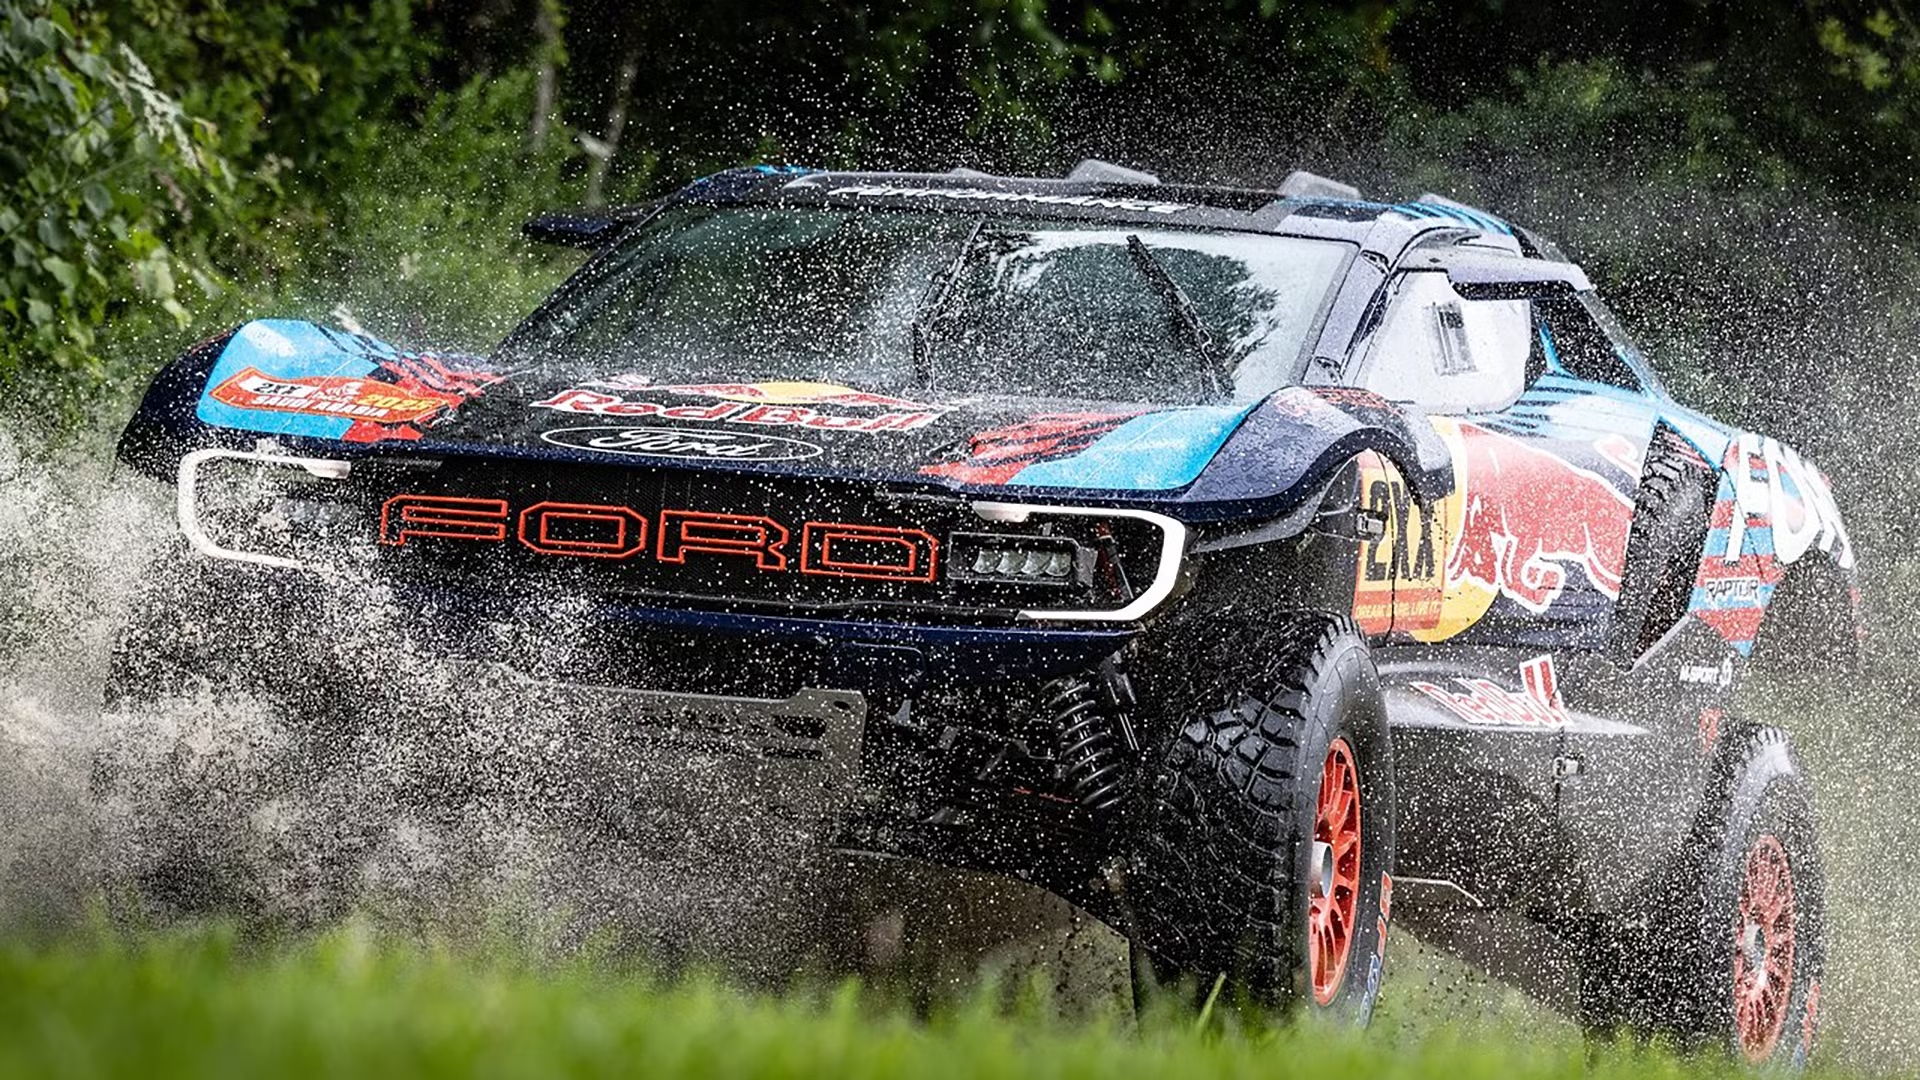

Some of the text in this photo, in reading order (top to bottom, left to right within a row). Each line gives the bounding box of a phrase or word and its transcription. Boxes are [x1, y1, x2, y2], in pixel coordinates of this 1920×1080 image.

[251, 396, 389, 417] SAUDI ARABIA
[253, 382, 302, 396] 2XX
[357, 394, 436, 411] 2025
[530, 389, 950, 432] Red Bull
[588, 429, 773, 457] Ford
[1723, 433, 1858, 570] FOR
[380, 494, 940, 581] FORD
[1365, 480, 1435, 581] 2XX
[1706, 580, 1759, 600] RAPTOR
[1409, 654, 1574, 728] Red Bull
